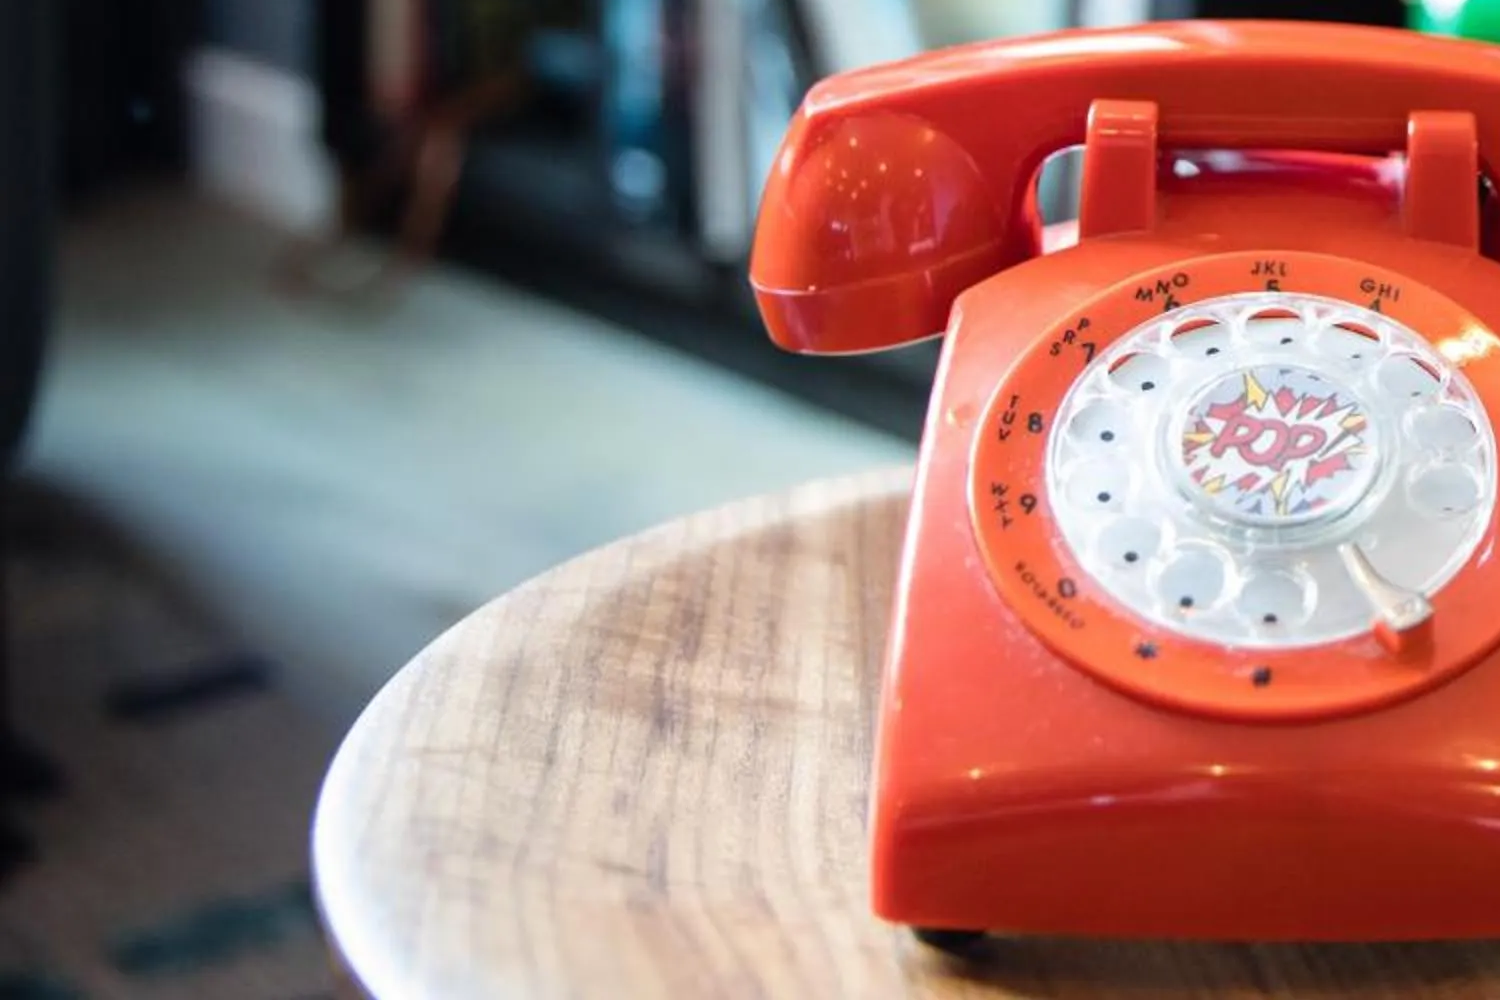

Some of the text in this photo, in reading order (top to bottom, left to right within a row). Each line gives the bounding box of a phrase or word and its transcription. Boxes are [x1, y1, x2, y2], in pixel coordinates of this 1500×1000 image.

[1251, 261, 1287, 276] JKL
[1360, 278, 1400, 301] GHI
[1081, 342, 1096, 366] 7
[1027, 411, 1042, 433] 8
[1209, 413, 1328, 472] POP
[1018, 493, 1037, 516] 9
